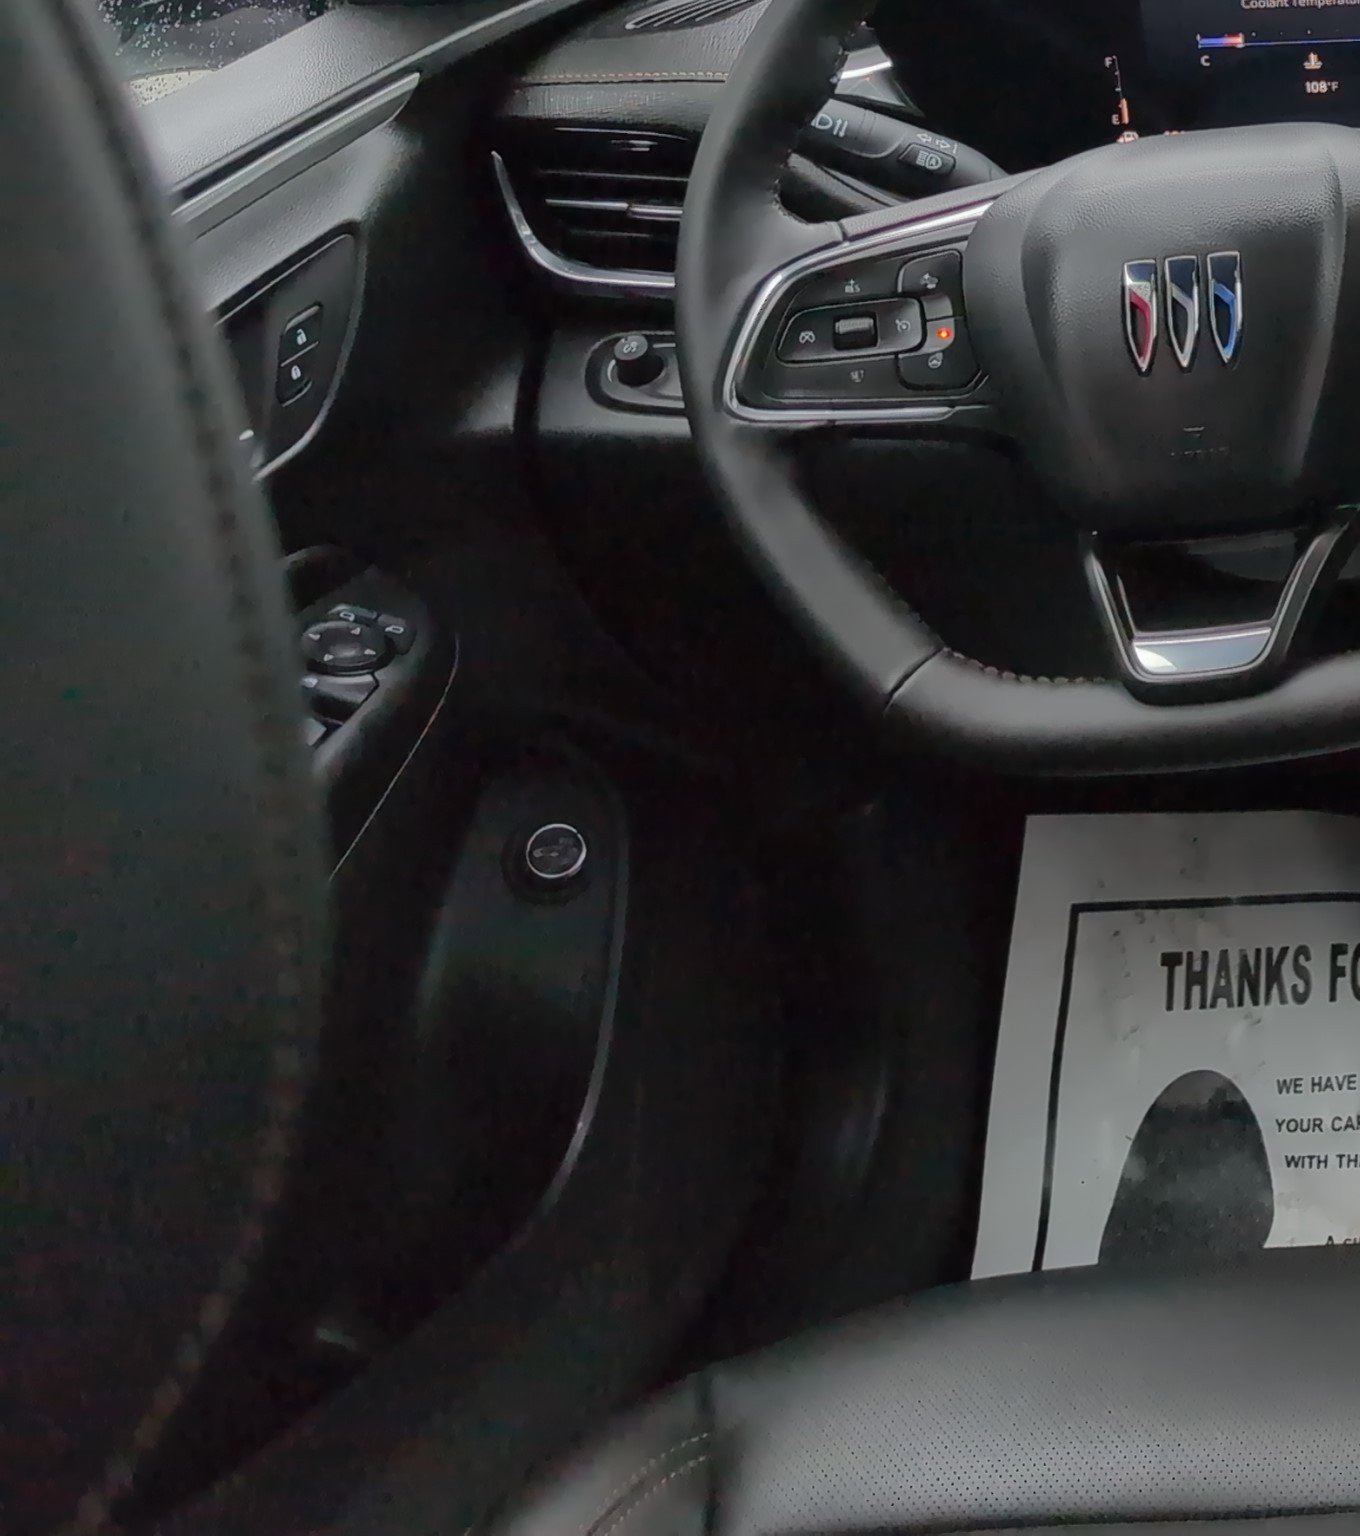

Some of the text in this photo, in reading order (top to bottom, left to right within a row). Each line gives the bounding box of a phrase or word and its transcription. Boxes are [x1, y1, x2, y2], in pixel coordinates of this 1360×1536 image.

[1160, 944, 1312, 1012] THANKS
[1276, 1078, 1303, 1095] WE
[1311, 1074, 1358, 1093] HAVE
[1275, 1118, 1324, 1133] YOUR
[1284, 1154, 1329, 1169] WITH
